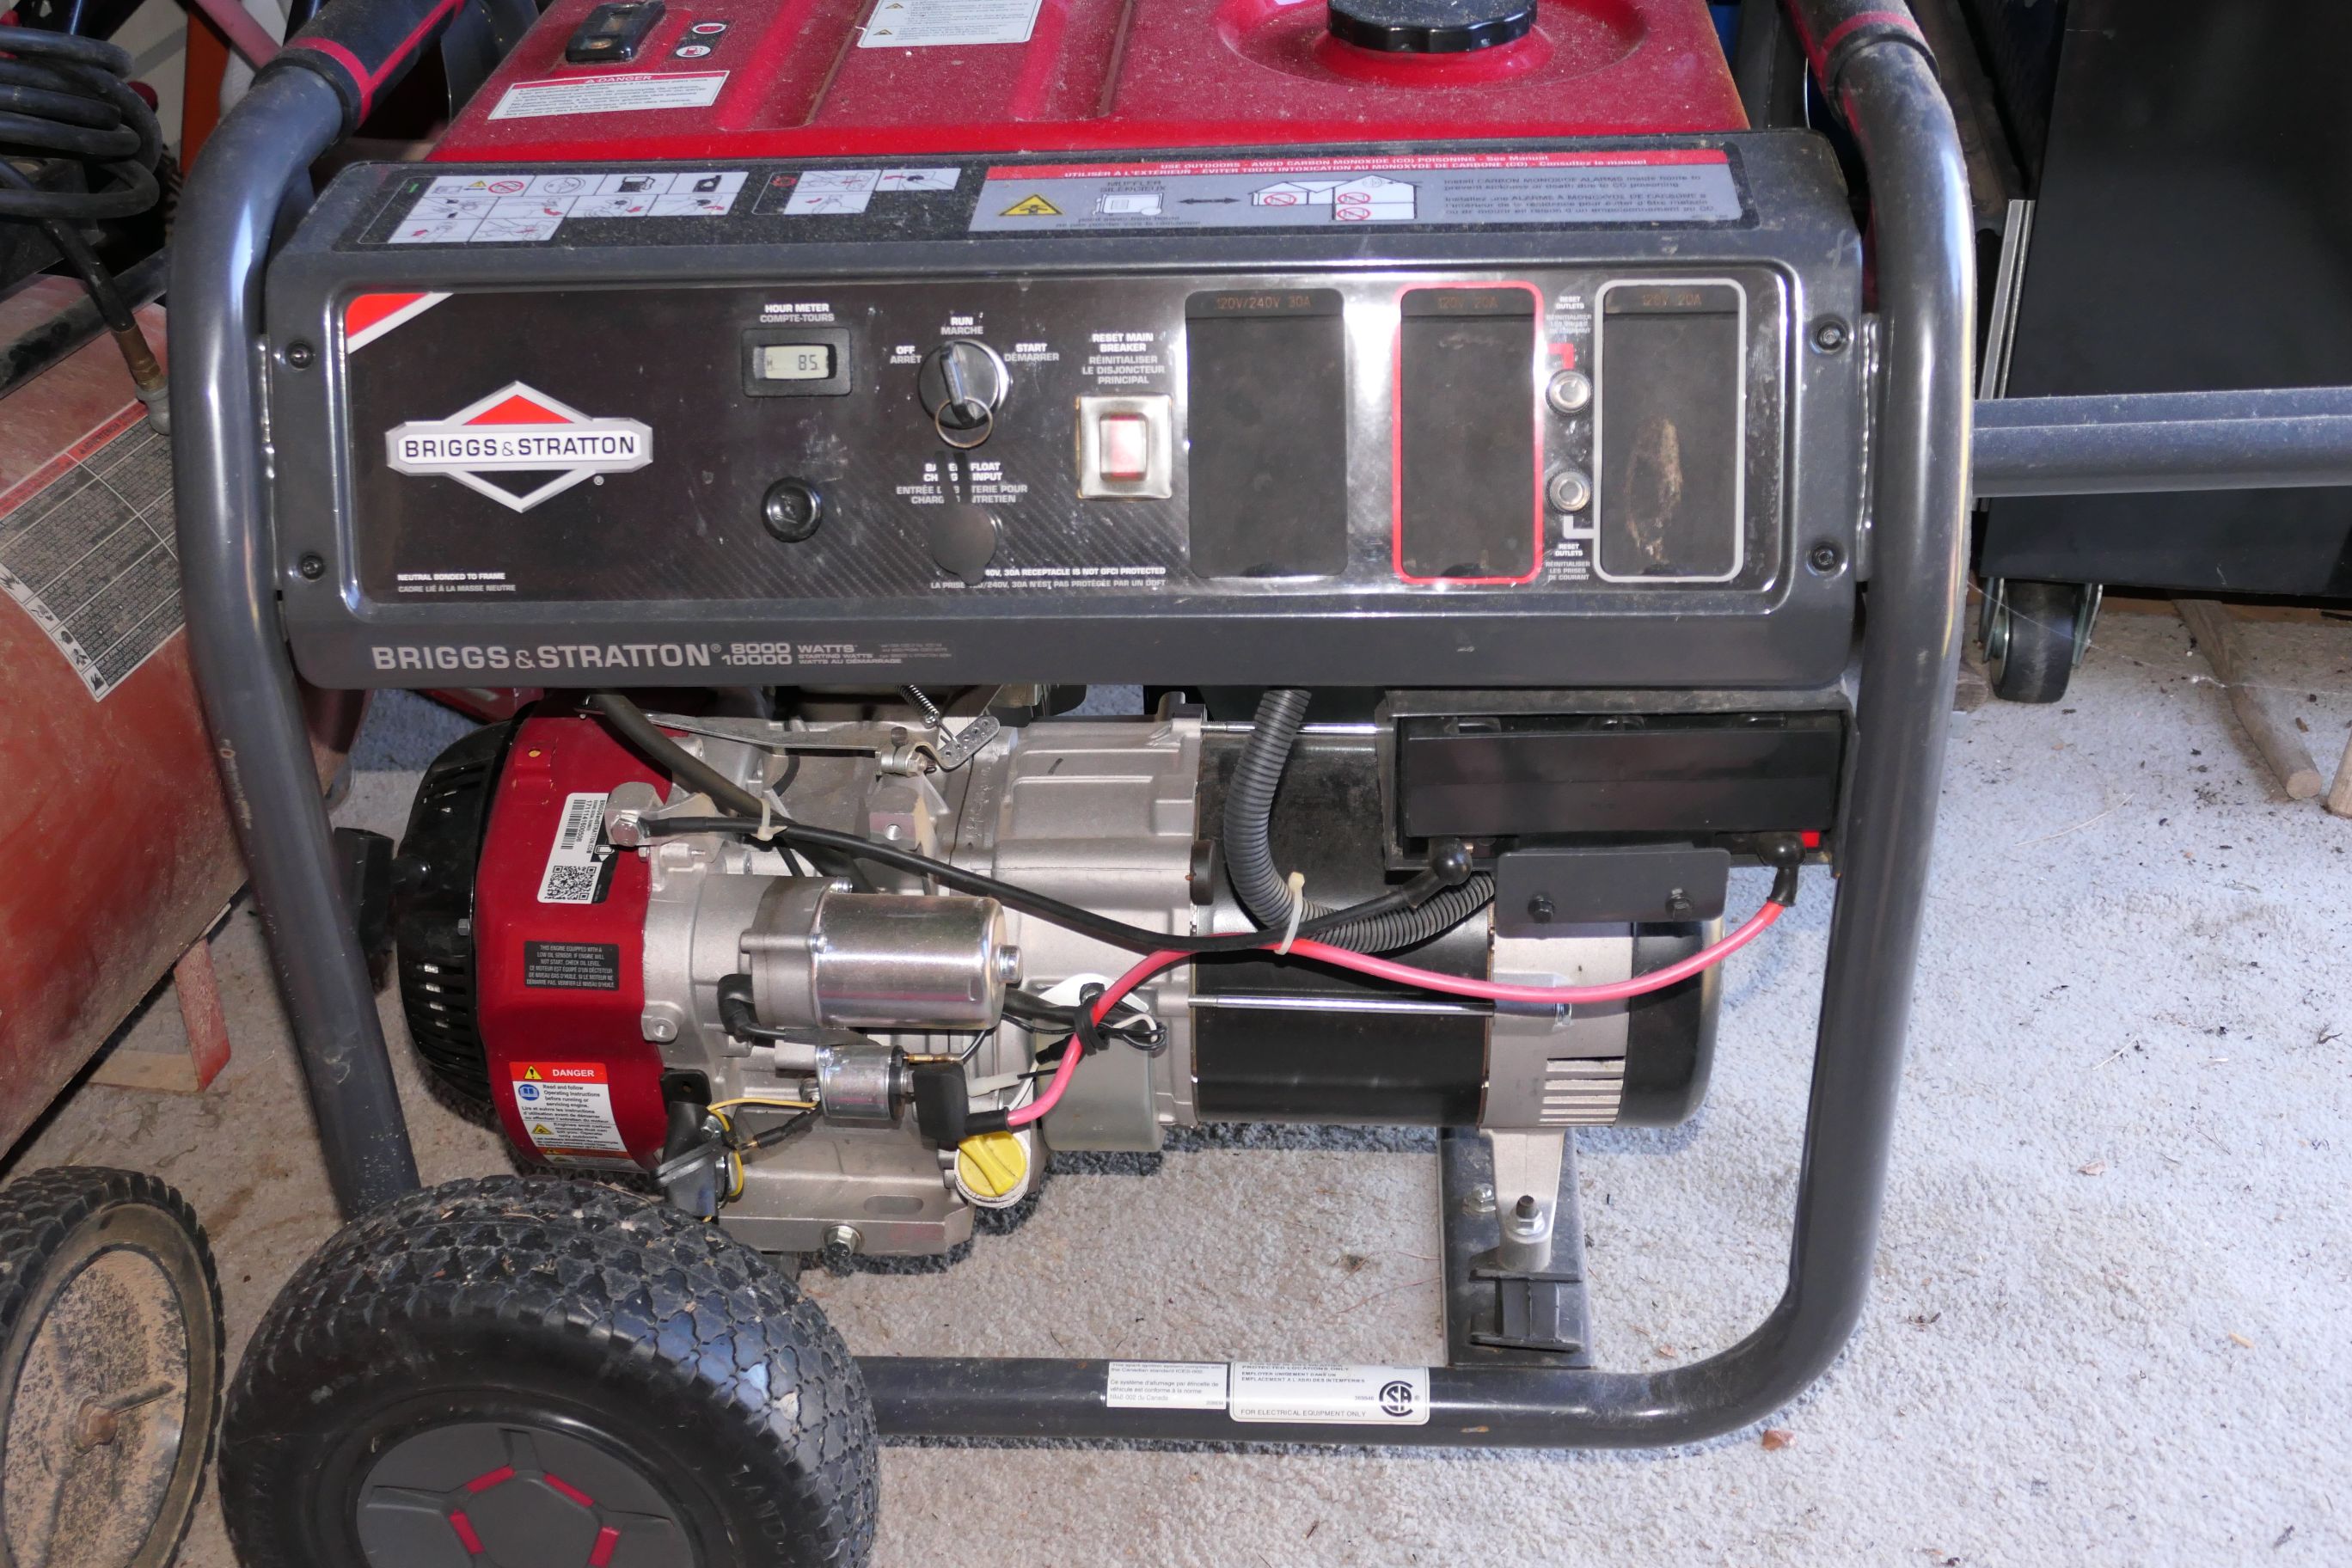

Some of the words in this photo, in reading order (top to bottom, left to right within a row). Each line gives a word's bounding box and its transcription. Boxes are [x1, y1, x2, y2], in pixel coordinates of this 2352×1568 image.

[597, 75, 652, 83] DANGER
[764, 303, 793, 313] HOUR
[794, 303, 830, 313] METER
[759, 314, 835, 323] COMPTE-TOURS
[950, 316, 973, 326] RUN
[940, 326, 983, 335] MARCHE
[1092, 333, 1124, 342] RESET
[1125, 332, 1154, 342] MAIN
[895, 346, 916, 355] OFF
[1015, 343, 1048, 352] START
[1099, 343, 1147, 352] BREAKER
[889, 354, 922, 364] ARRÊT
[1003, 352, 1060, 362] DÉMARRER
[1088, 353, 1158, 364] RÉINITIALISER
[1081, 366, 1094, 375] LE
[1096, 364, 1166, 375] DISJONCTEUR
[1098, 376, 1149, 385] PRINCIPAL
[969, 462, 1001, 471] FLOAT
[971, 472, 1002, 481] INPUT
[896, 484, 934, 495] ENTRÉE
[1000, 484, 1027, 493] POUR
[910, 495, 945, 505] CHARG
[1021, 567, 1070, 576] RECEPTACLE
[1072, 567, 1081, 576] IS
[1081, 567, 1099, 576] NOT
[1119, 567, 1167, 575] PROTECTED
[433, 573, 466, 581] BONDED
[1071, 579, 1112, 587] PROTÉGÉE
[485, 584, 516, 592] NEUTRE
[731, 642, 790, 654] 8000
[721, 653, 793, 665] 10000
[552, 1069, 595, 1077] DANGER
